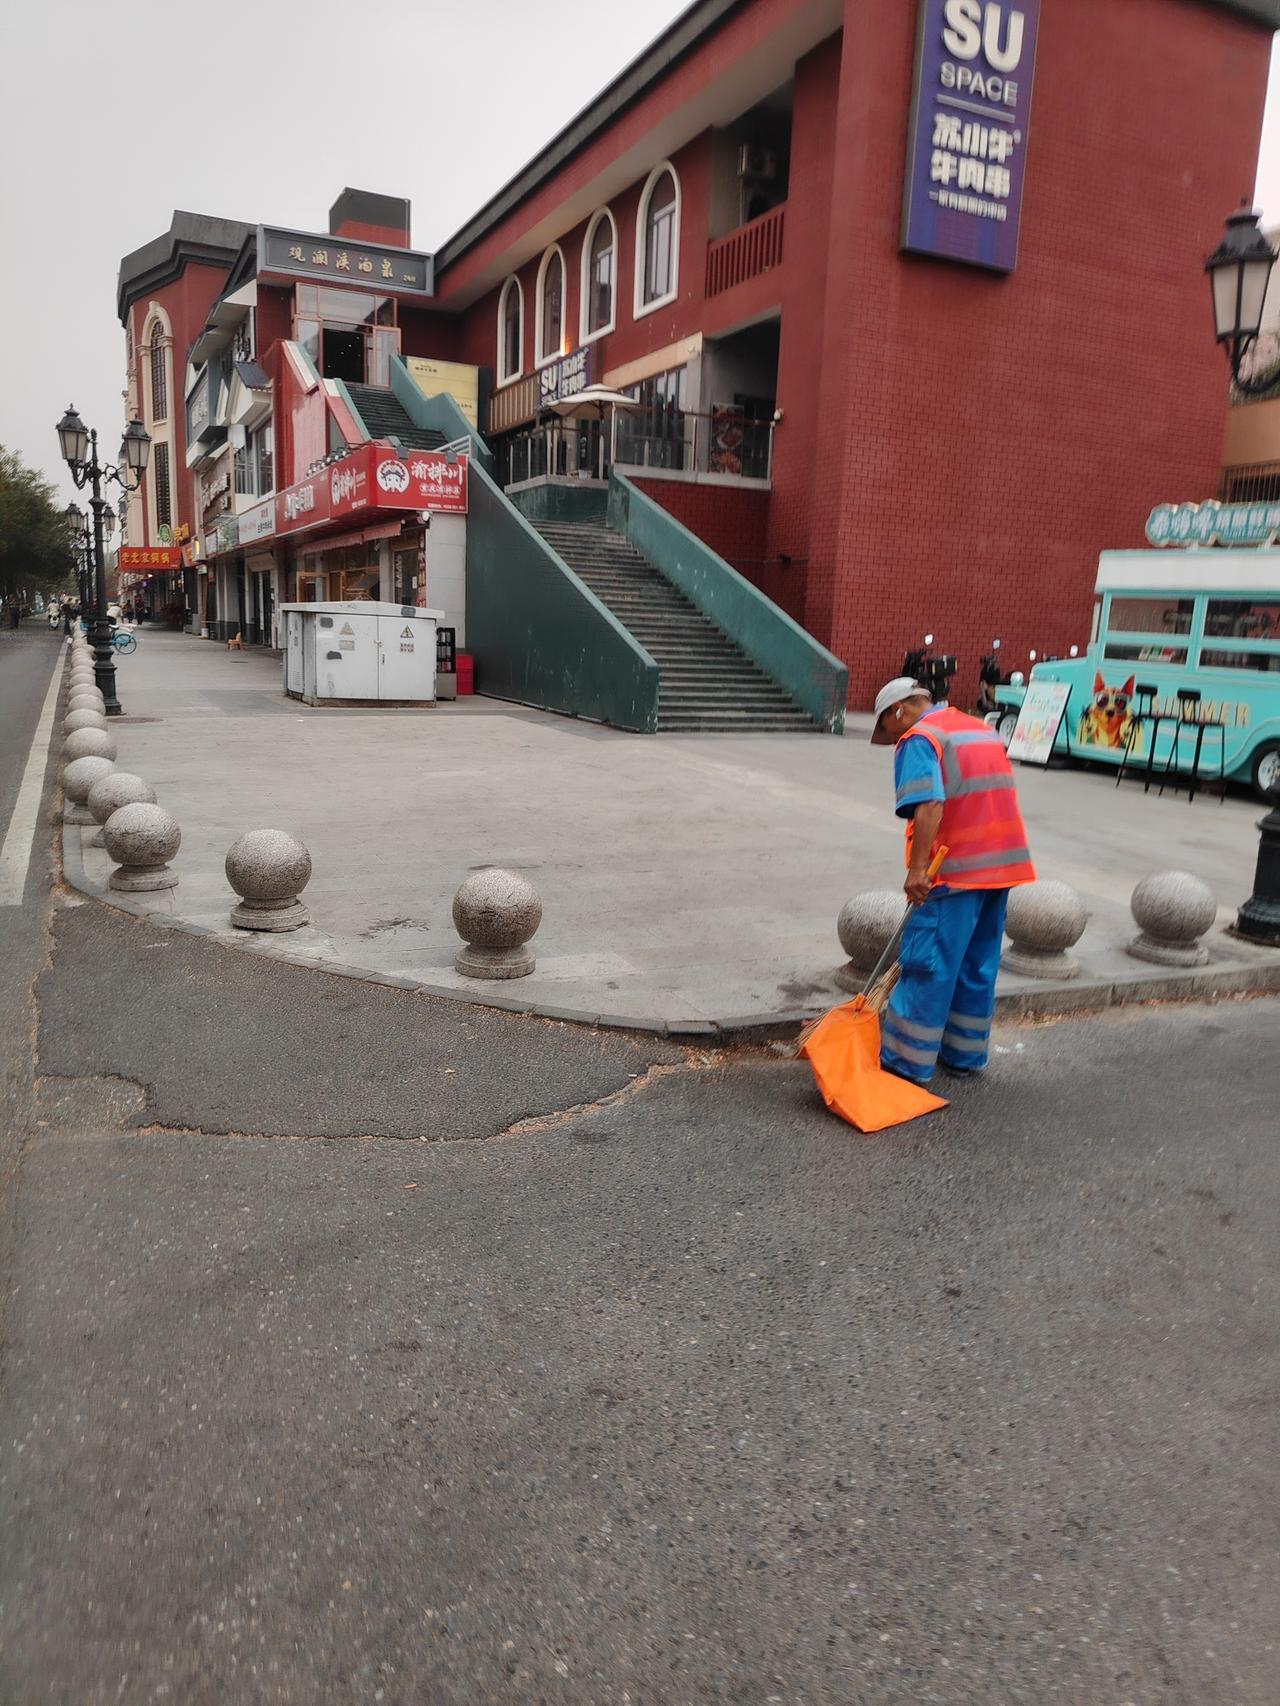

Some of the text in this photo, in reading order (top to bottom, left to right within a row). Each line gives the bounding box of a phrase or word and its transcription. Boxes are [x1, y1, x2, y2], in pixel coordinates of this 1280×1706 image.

[943, 0, 1025, 73] SU
[940, 61, 1019, 108] SPACE
[541, 364, 558, 396] SU
